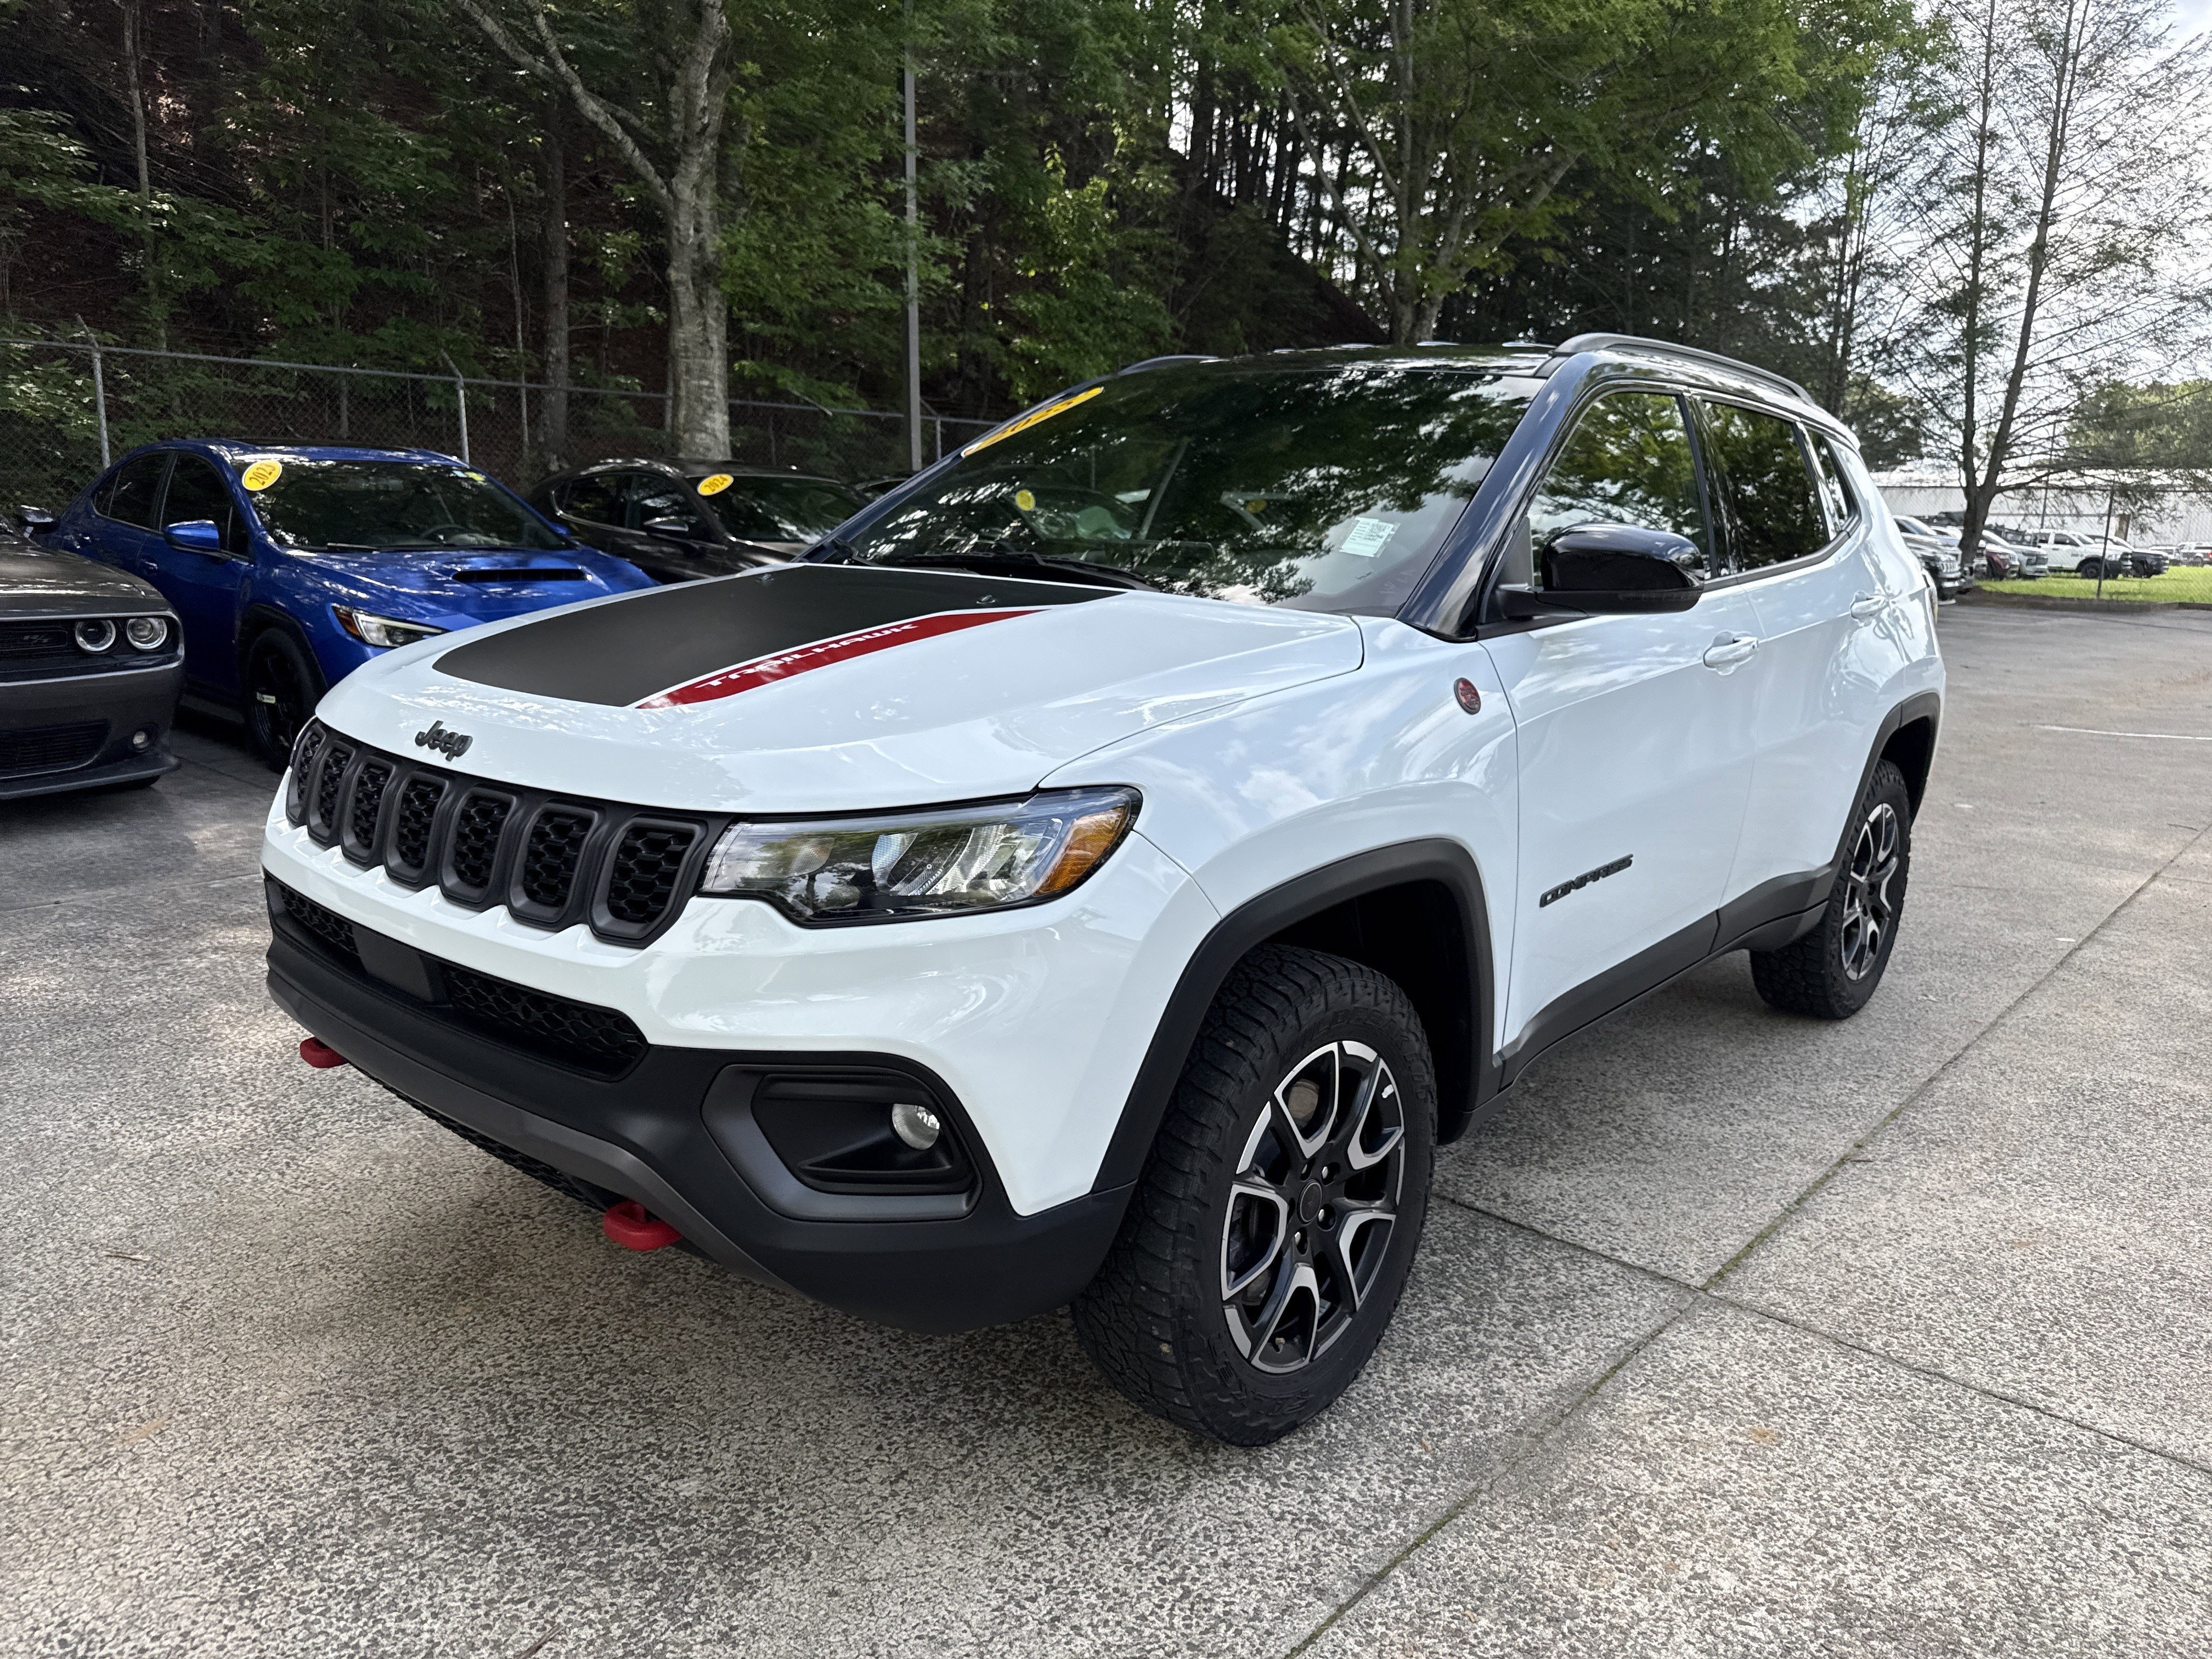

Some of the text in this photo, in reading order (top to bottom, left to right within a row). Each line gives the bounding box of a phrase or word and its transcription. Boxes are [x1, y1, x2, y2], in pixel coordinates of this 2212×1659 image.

[695, 623, 919, 690] TRAILHAWK
[414, 720, 473, 762] Jeep
[1539, 853, 1634, 909] COMPASS
